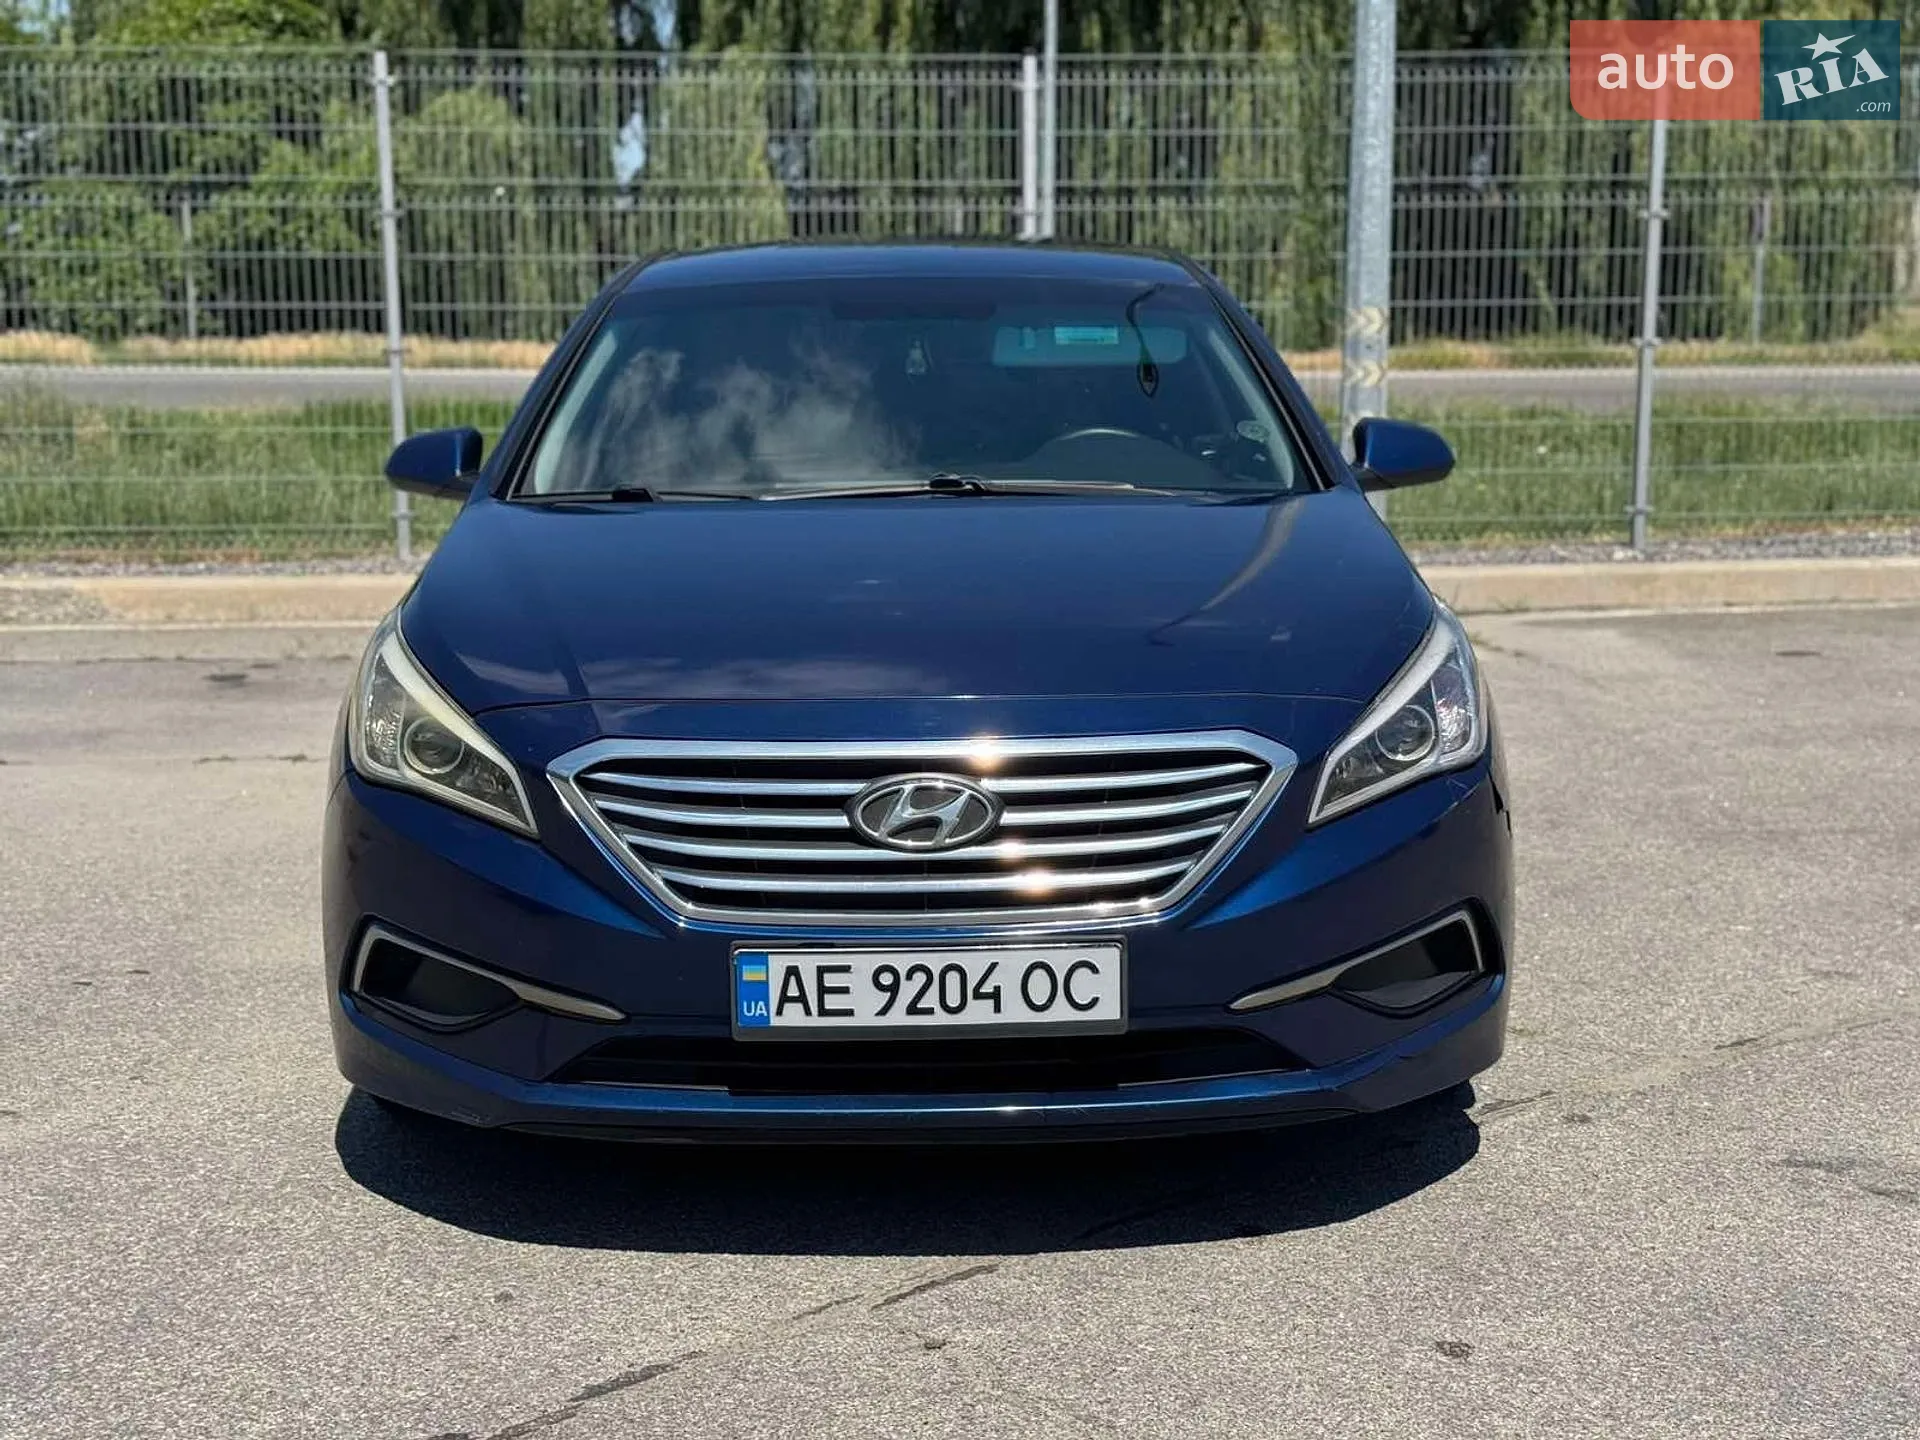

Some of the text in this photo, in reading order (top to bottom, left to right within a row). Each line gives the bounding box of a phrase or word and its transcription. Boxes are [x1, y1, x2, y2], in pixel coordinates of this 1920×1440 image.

[775, 959, 1100, 1017] AE 9204 OC
[743, 1001, 767, 1017] UA
